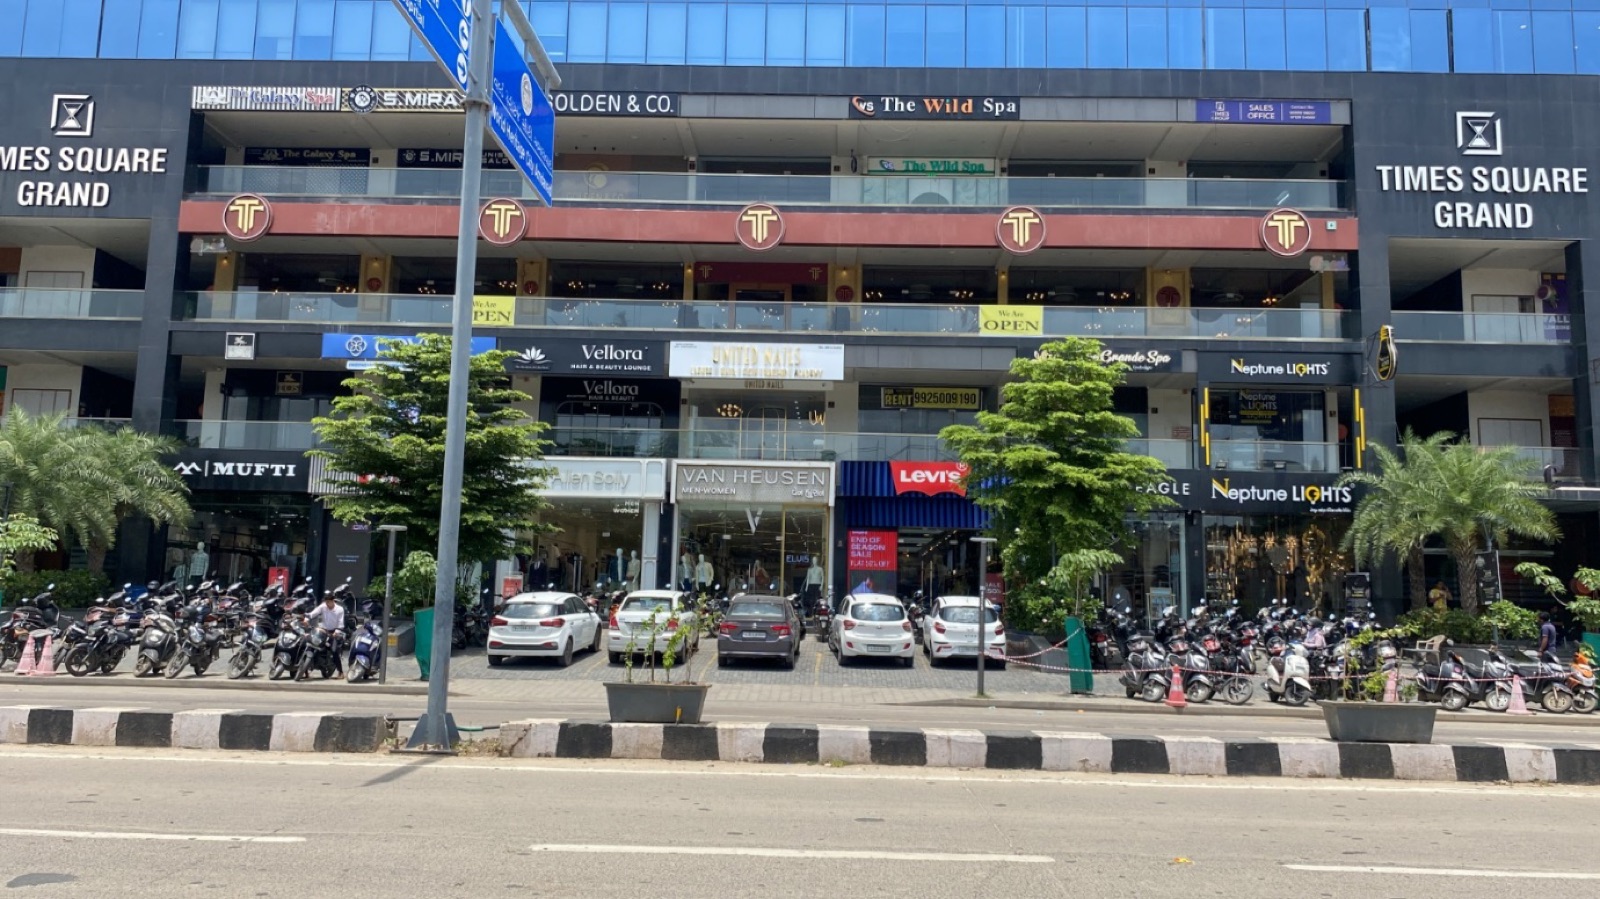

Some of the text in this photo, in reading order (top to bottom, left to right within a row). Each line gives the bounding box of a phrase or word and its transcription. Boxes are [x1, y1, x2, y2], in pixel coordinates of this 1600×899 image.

[250, 91, 302, 106] Galaxy
[305, 91, 336, 107] Spa
[627, 95, 640, 112] &
[646, 95, 674, 112] CO.
[881, 97, 915, 112] The
[923, 98, 973, 114] Wild
[983, 98, 1016, 116] Spa
[1247, 112, 1275, 120] OFFICE
[1248, 104, 1273, 112] SALES
[0, 146, 168, 173] MES SQUARE
[303, 149, 335, 160] Galaxy
[338, 150, 356, 161] Spa
[419, 151, 464, 163] S.MIR
[903, 161, 926, 172] The
[930, 161, 959, 172] Wild
[962, 161, 985, 174] Spa
[1375, 165, 1590, 194] TIMES SQUARE
[17, 180, 111, 207] GRAND
[1435, 201, 1533, 229] GRAND
[473, 311, 511, 323] PEN
[998, 309, 1025, 319] We Are
[983, 319, 1040, 332] OPEN
[581, 344, 643, 361] Vellora
[1146, 350, 1171, 366] Spa
[1230, 358, 1328, 379] Neptune LIGHTS
[583, 380, 639, 396] Vellora
[884, 394, 914, 406] RENT
[212, 462, 297, 477] MUFTI
[683, 468, 826, 486] VAN HEUSEN
[551, 470, 633, 493] Allen Solly
[1211, 478, 1352, 504] Neptune LIGHTS
